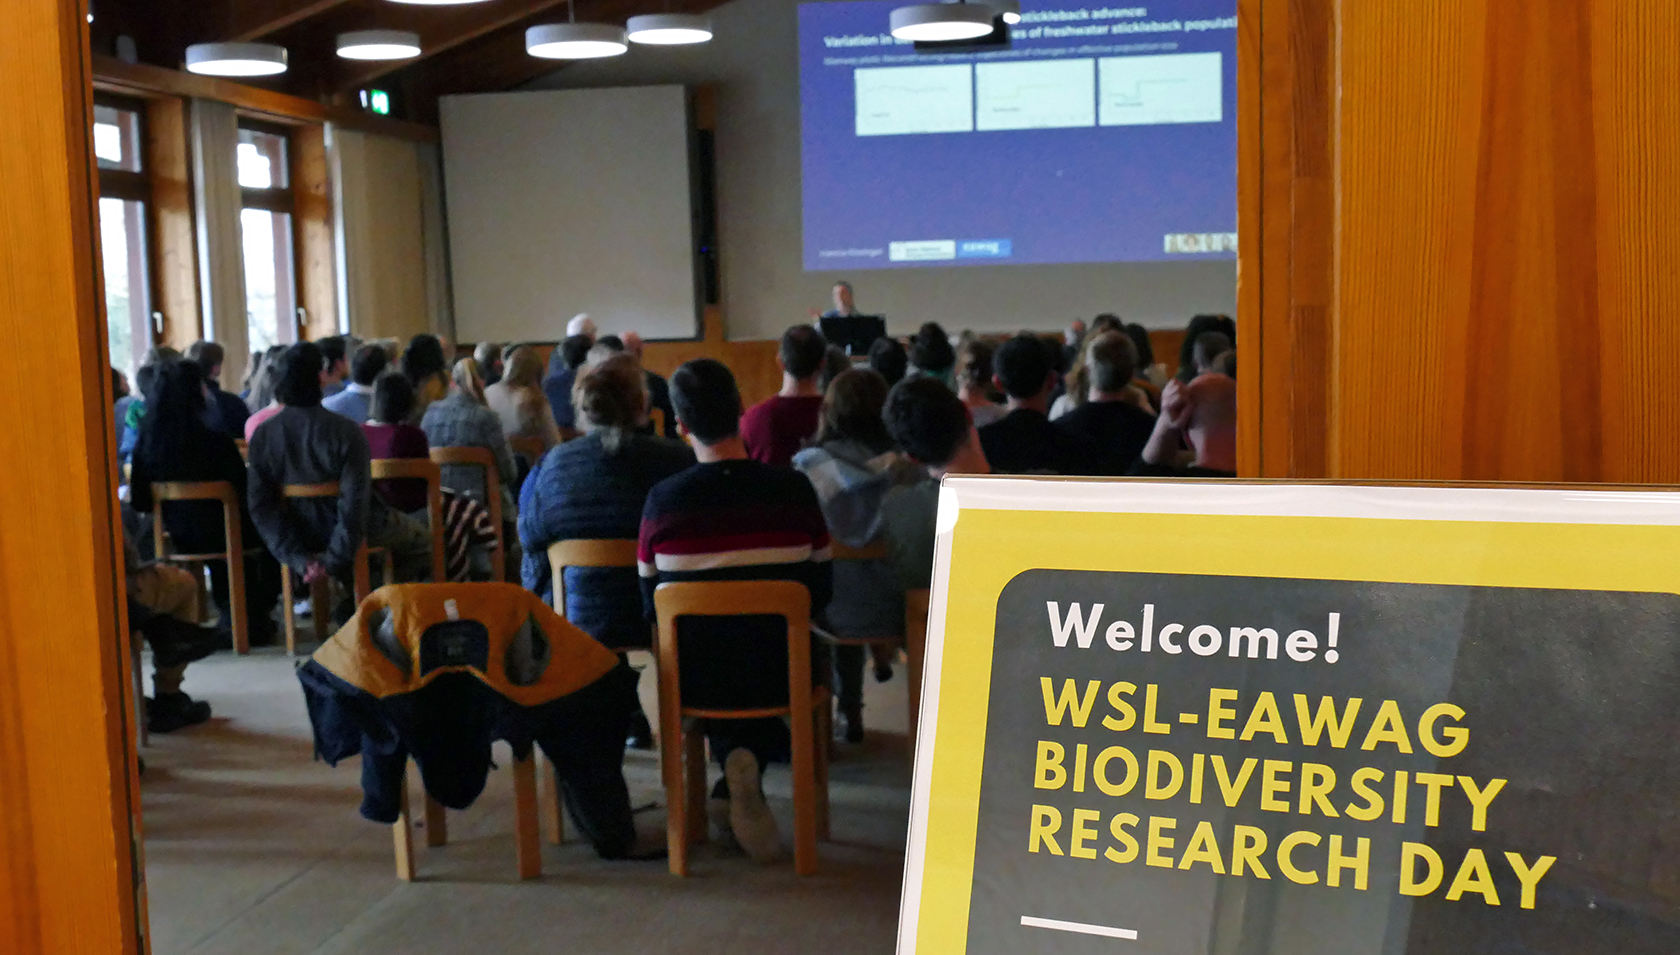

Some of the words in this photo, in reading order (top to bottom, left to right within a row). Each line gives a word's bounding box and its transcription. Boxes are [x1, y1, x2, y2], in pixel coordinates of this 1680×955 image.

[823, 34, 879, 48] Variation
[1043, 24, 1109, 38] freshwater
[1111, 20, 1182, 35] stickleback
[1046, 600, 1342, 664] Welcome!
[1039, 676, 1470, 758] WSL-EAWAG
[1033, 740, 1508, 833] BIODIVERSITY
[1028, 804, 1371, 891] RESEARCH
[1398, 841, 1558, 910] DAY
